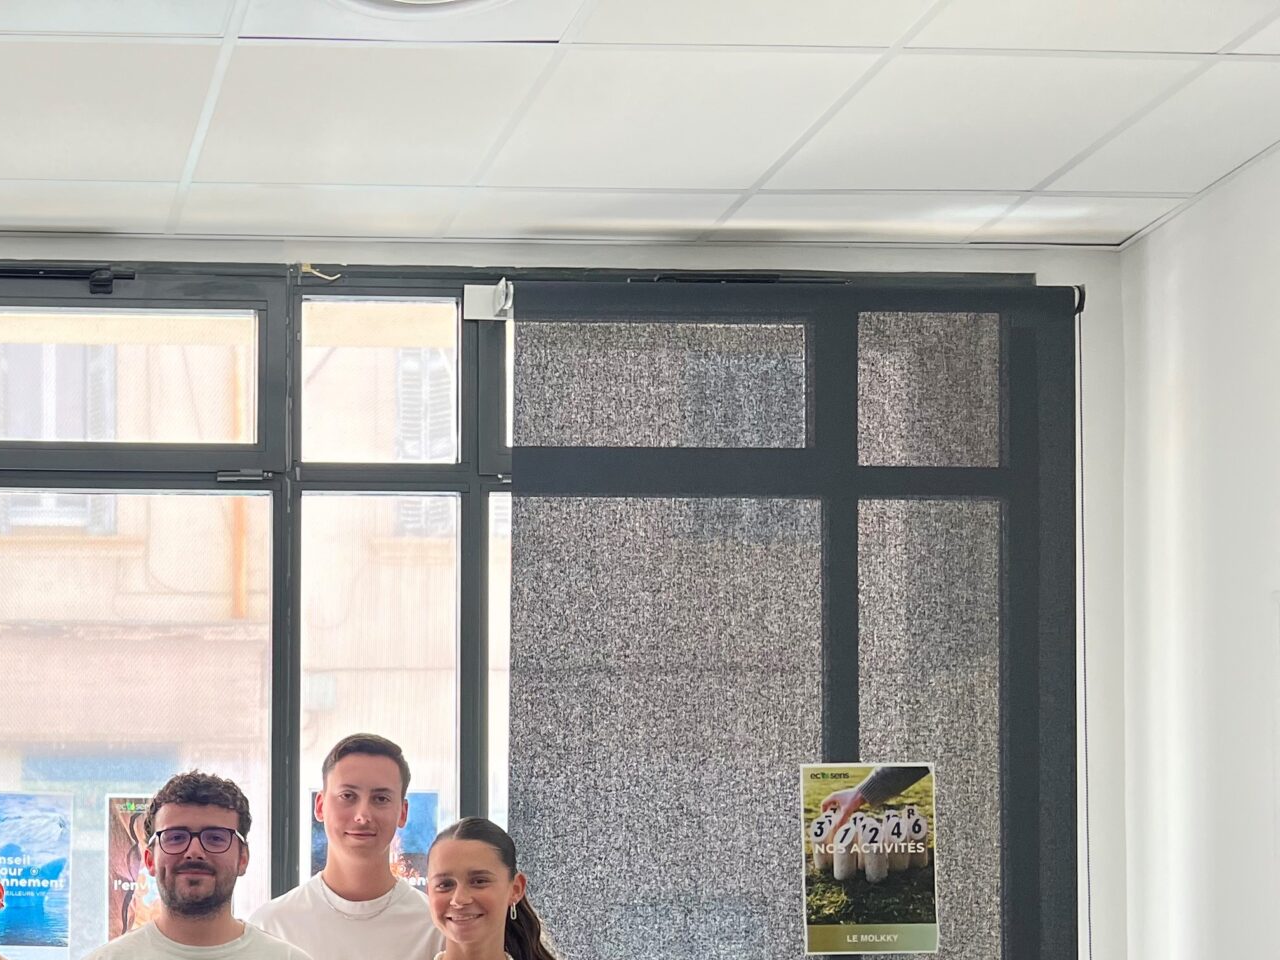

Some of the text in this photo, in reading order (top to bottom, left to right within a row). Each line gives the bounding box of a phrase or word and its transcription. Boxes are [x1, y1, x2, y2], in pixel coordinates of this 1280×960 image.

[849, 840, 925, 854] ACTIVITÉS
[846, 933, 899, 943] LE MOLKKY
